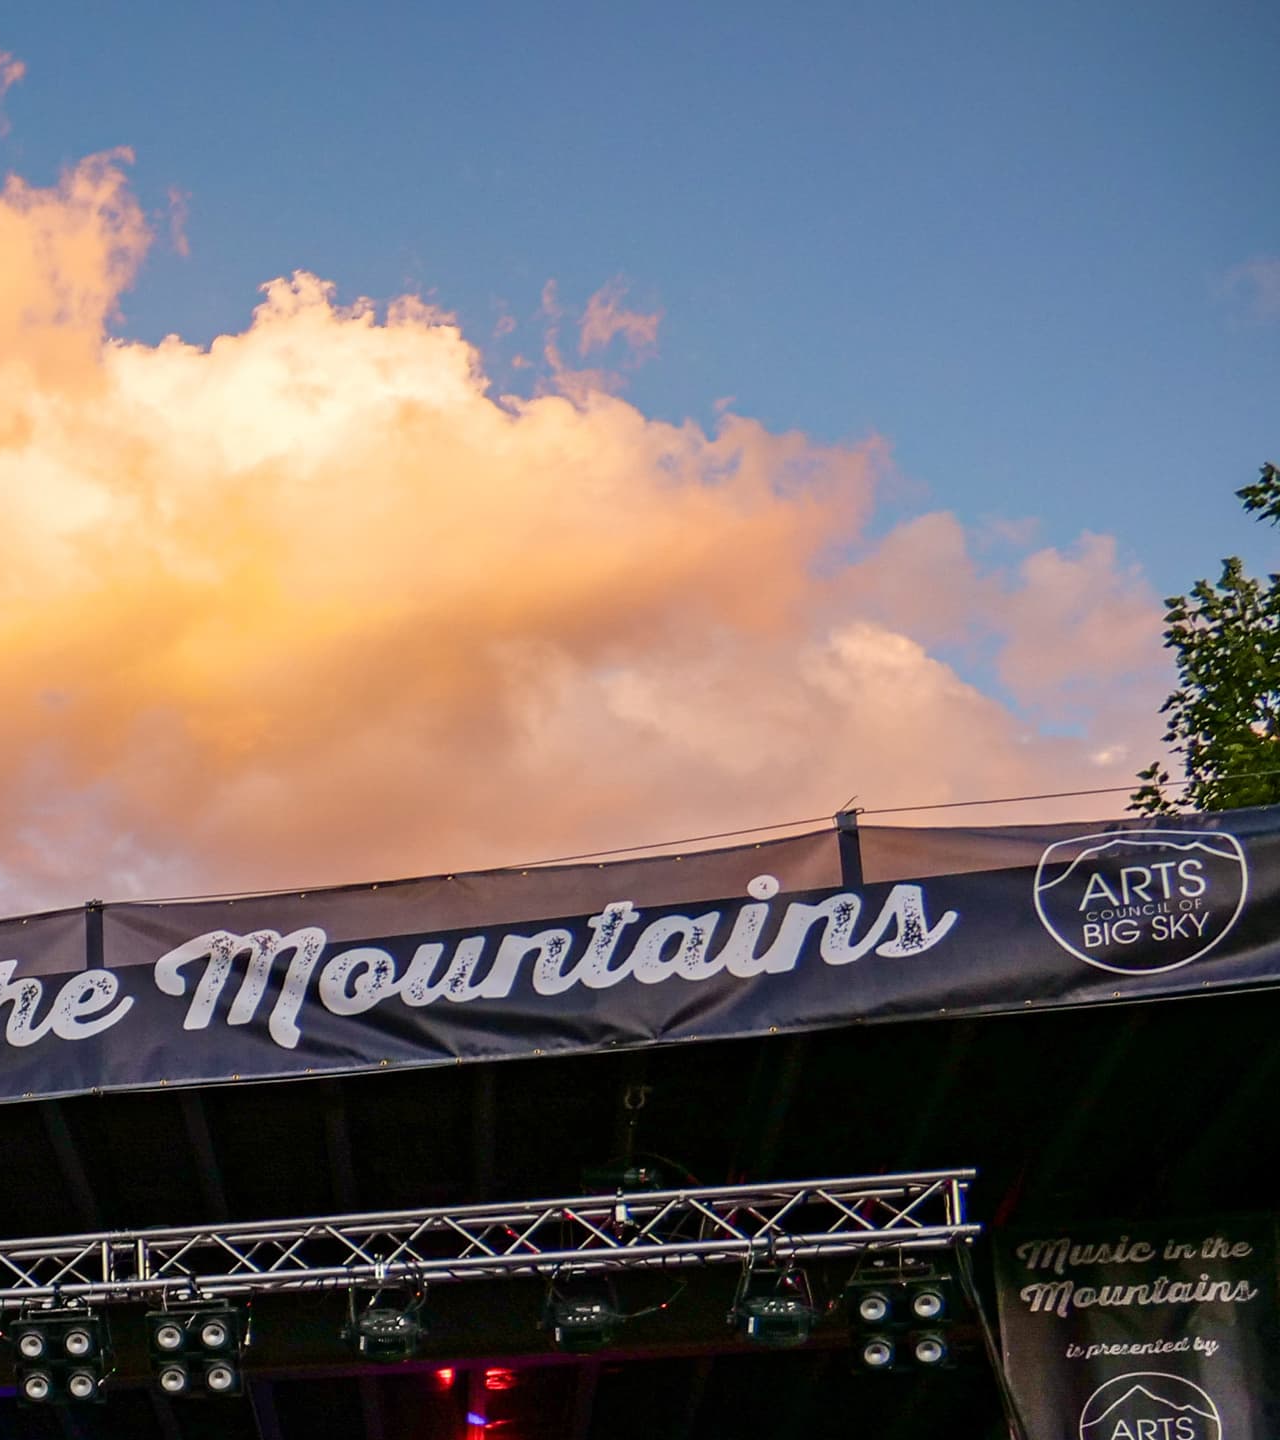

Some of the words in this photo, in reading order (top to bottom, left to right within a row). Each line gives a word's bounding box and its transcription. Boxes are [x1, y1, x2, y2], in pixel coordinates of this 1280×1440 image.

[1078, 859, 1207, 912] ARTS
[1083, 918, 1140, 948] BIG
[1151, 911, 1210, 941] SKY
[1086, 903, 1171, 922] COUNCIL
[1178, 897, 1203, 912] OF
[154, 873, 959, 1049] Mountains
[1016, 1235, 1156, 1275] Music
[1163, 1239, 1196, 1260] in
[1195, 1236, 1254, 1259] the
[1020, 1273, 1259, 1318] Mountains
[1066, 1343, 1085, 1359] is
[1085, 1336, 1190, 1359] presented
[1192, 1336, 1220, 1357] by
